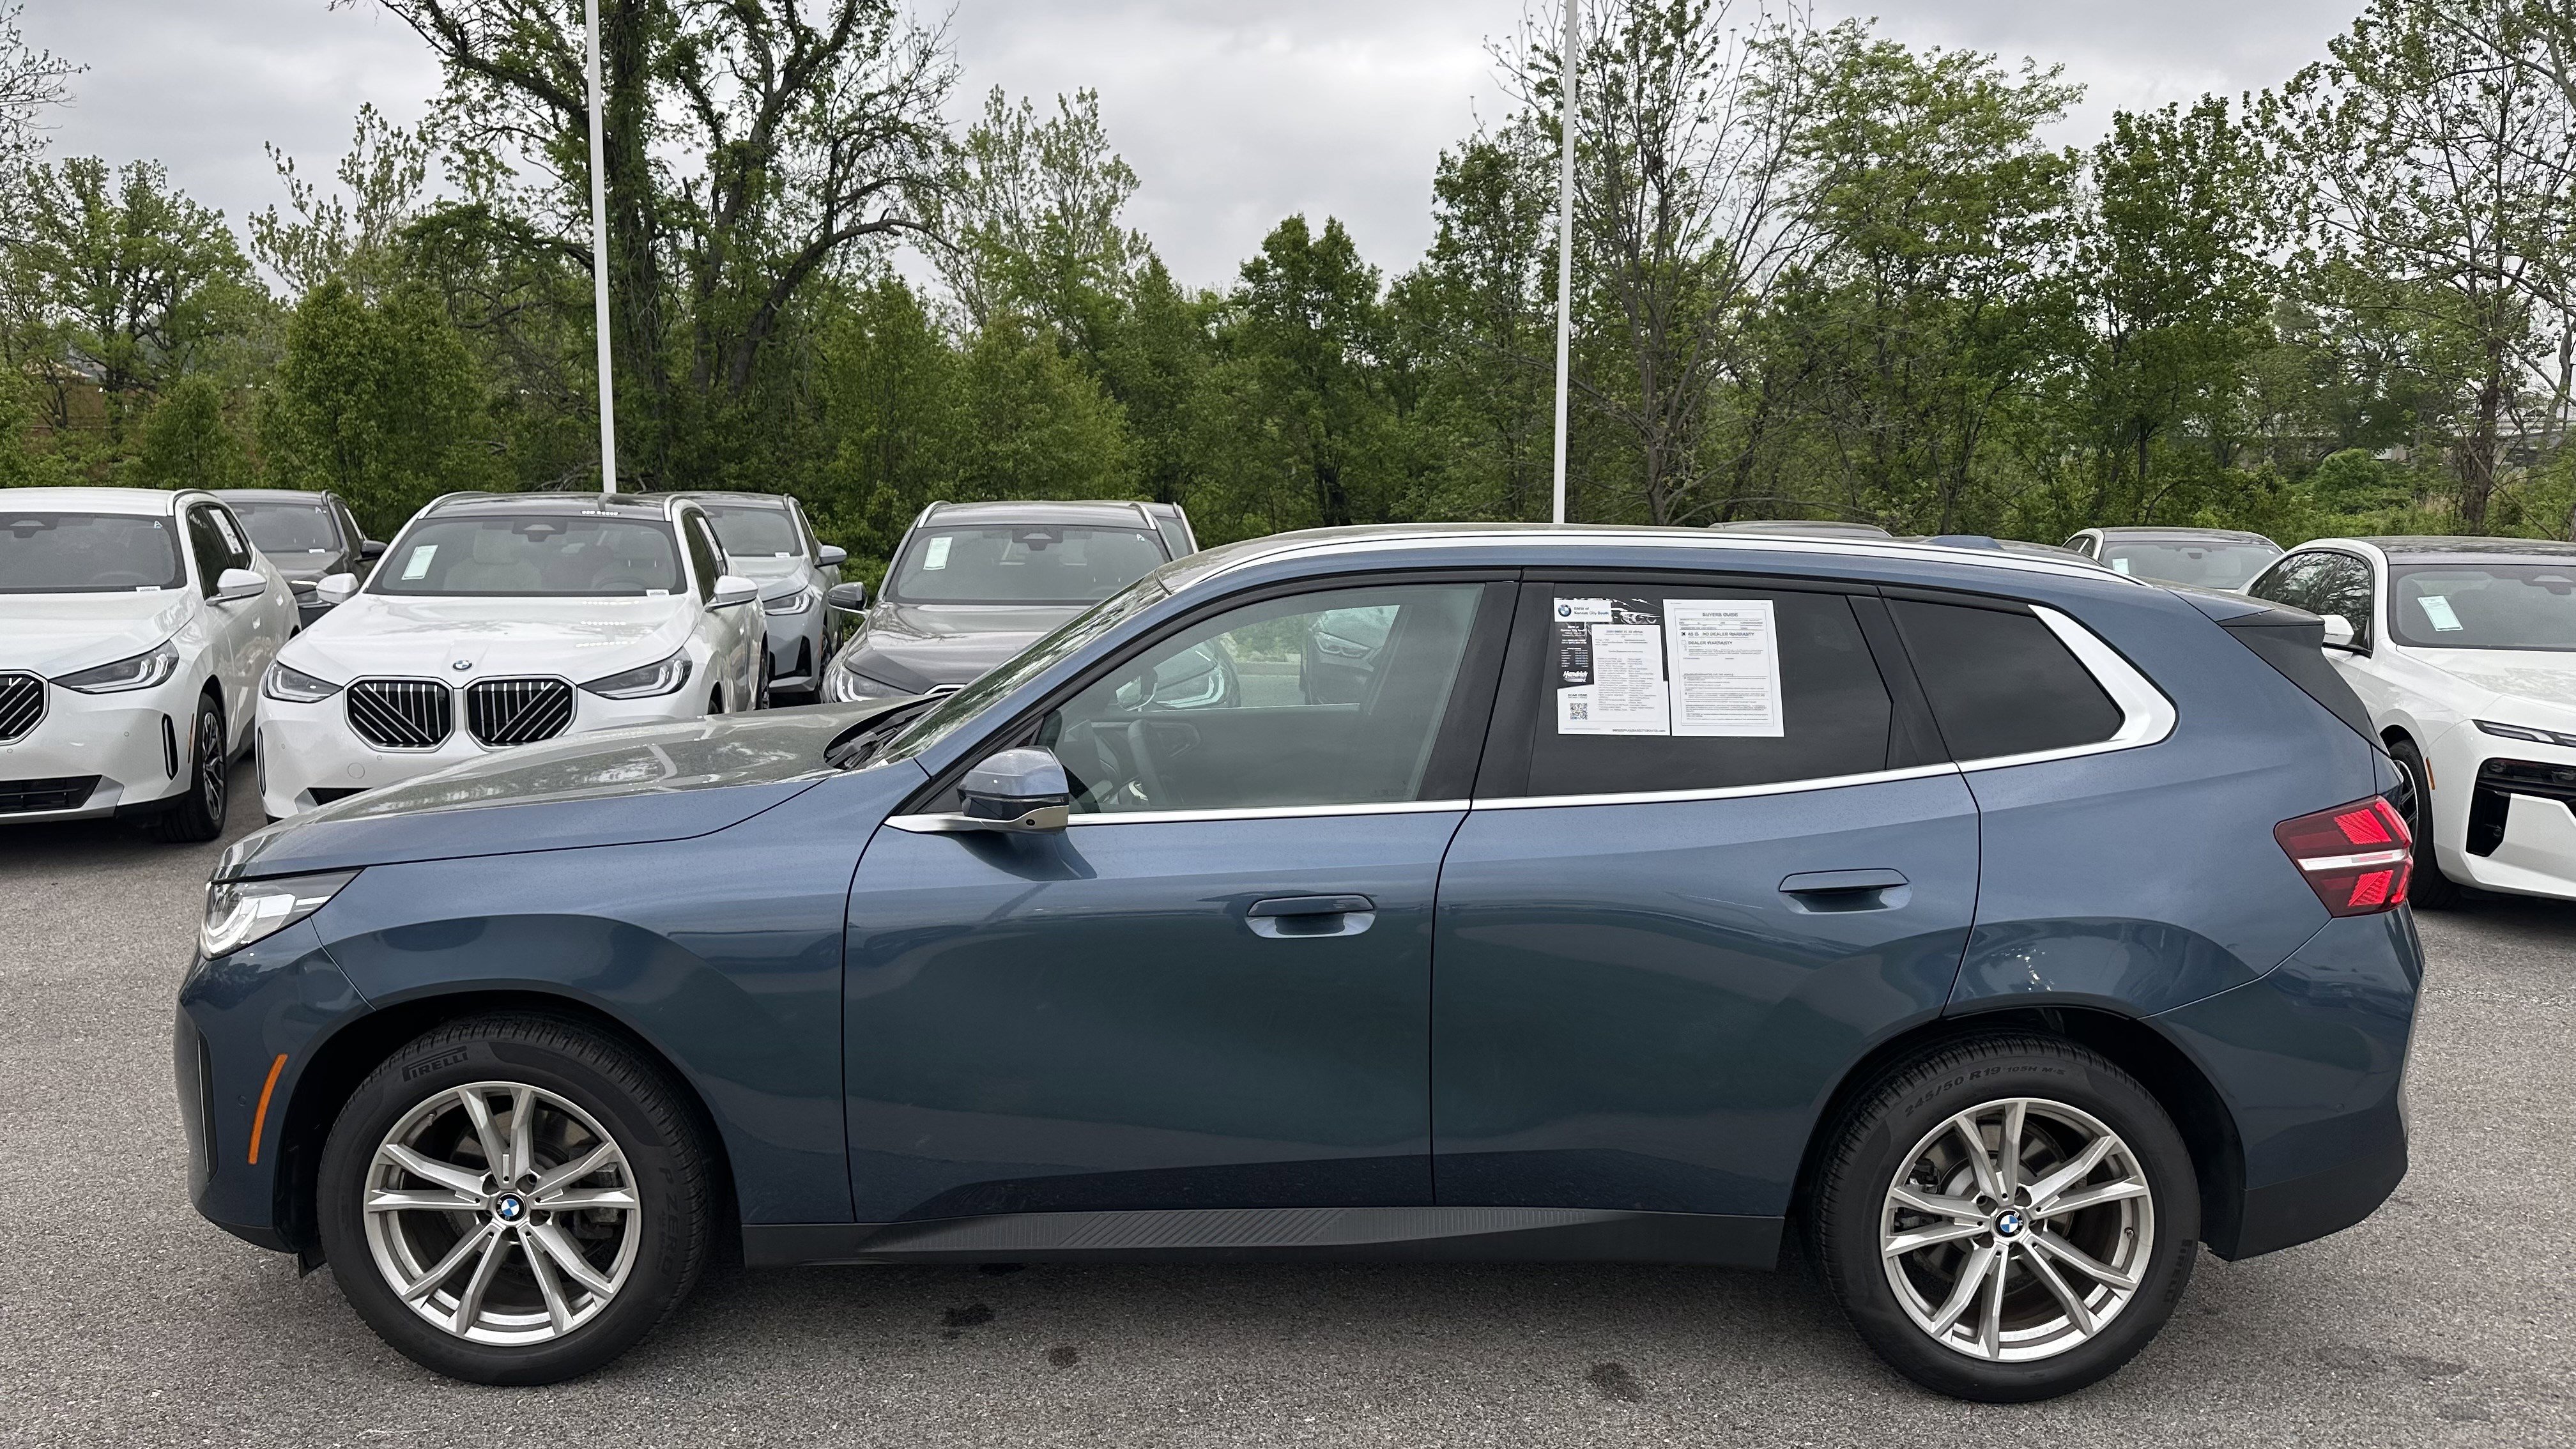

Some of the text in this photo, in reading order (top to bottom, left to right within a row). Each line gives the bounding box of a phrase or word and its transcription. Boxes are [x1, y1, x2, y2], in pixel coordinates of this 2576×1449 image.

[1563, 670, 1588, 678] Hendrick
[401, 1044, 470, 1082] PIRELLI
[1904, 1076, 1965, 1119] 245/50
[1969, 1066, 2002, 1080] R19
